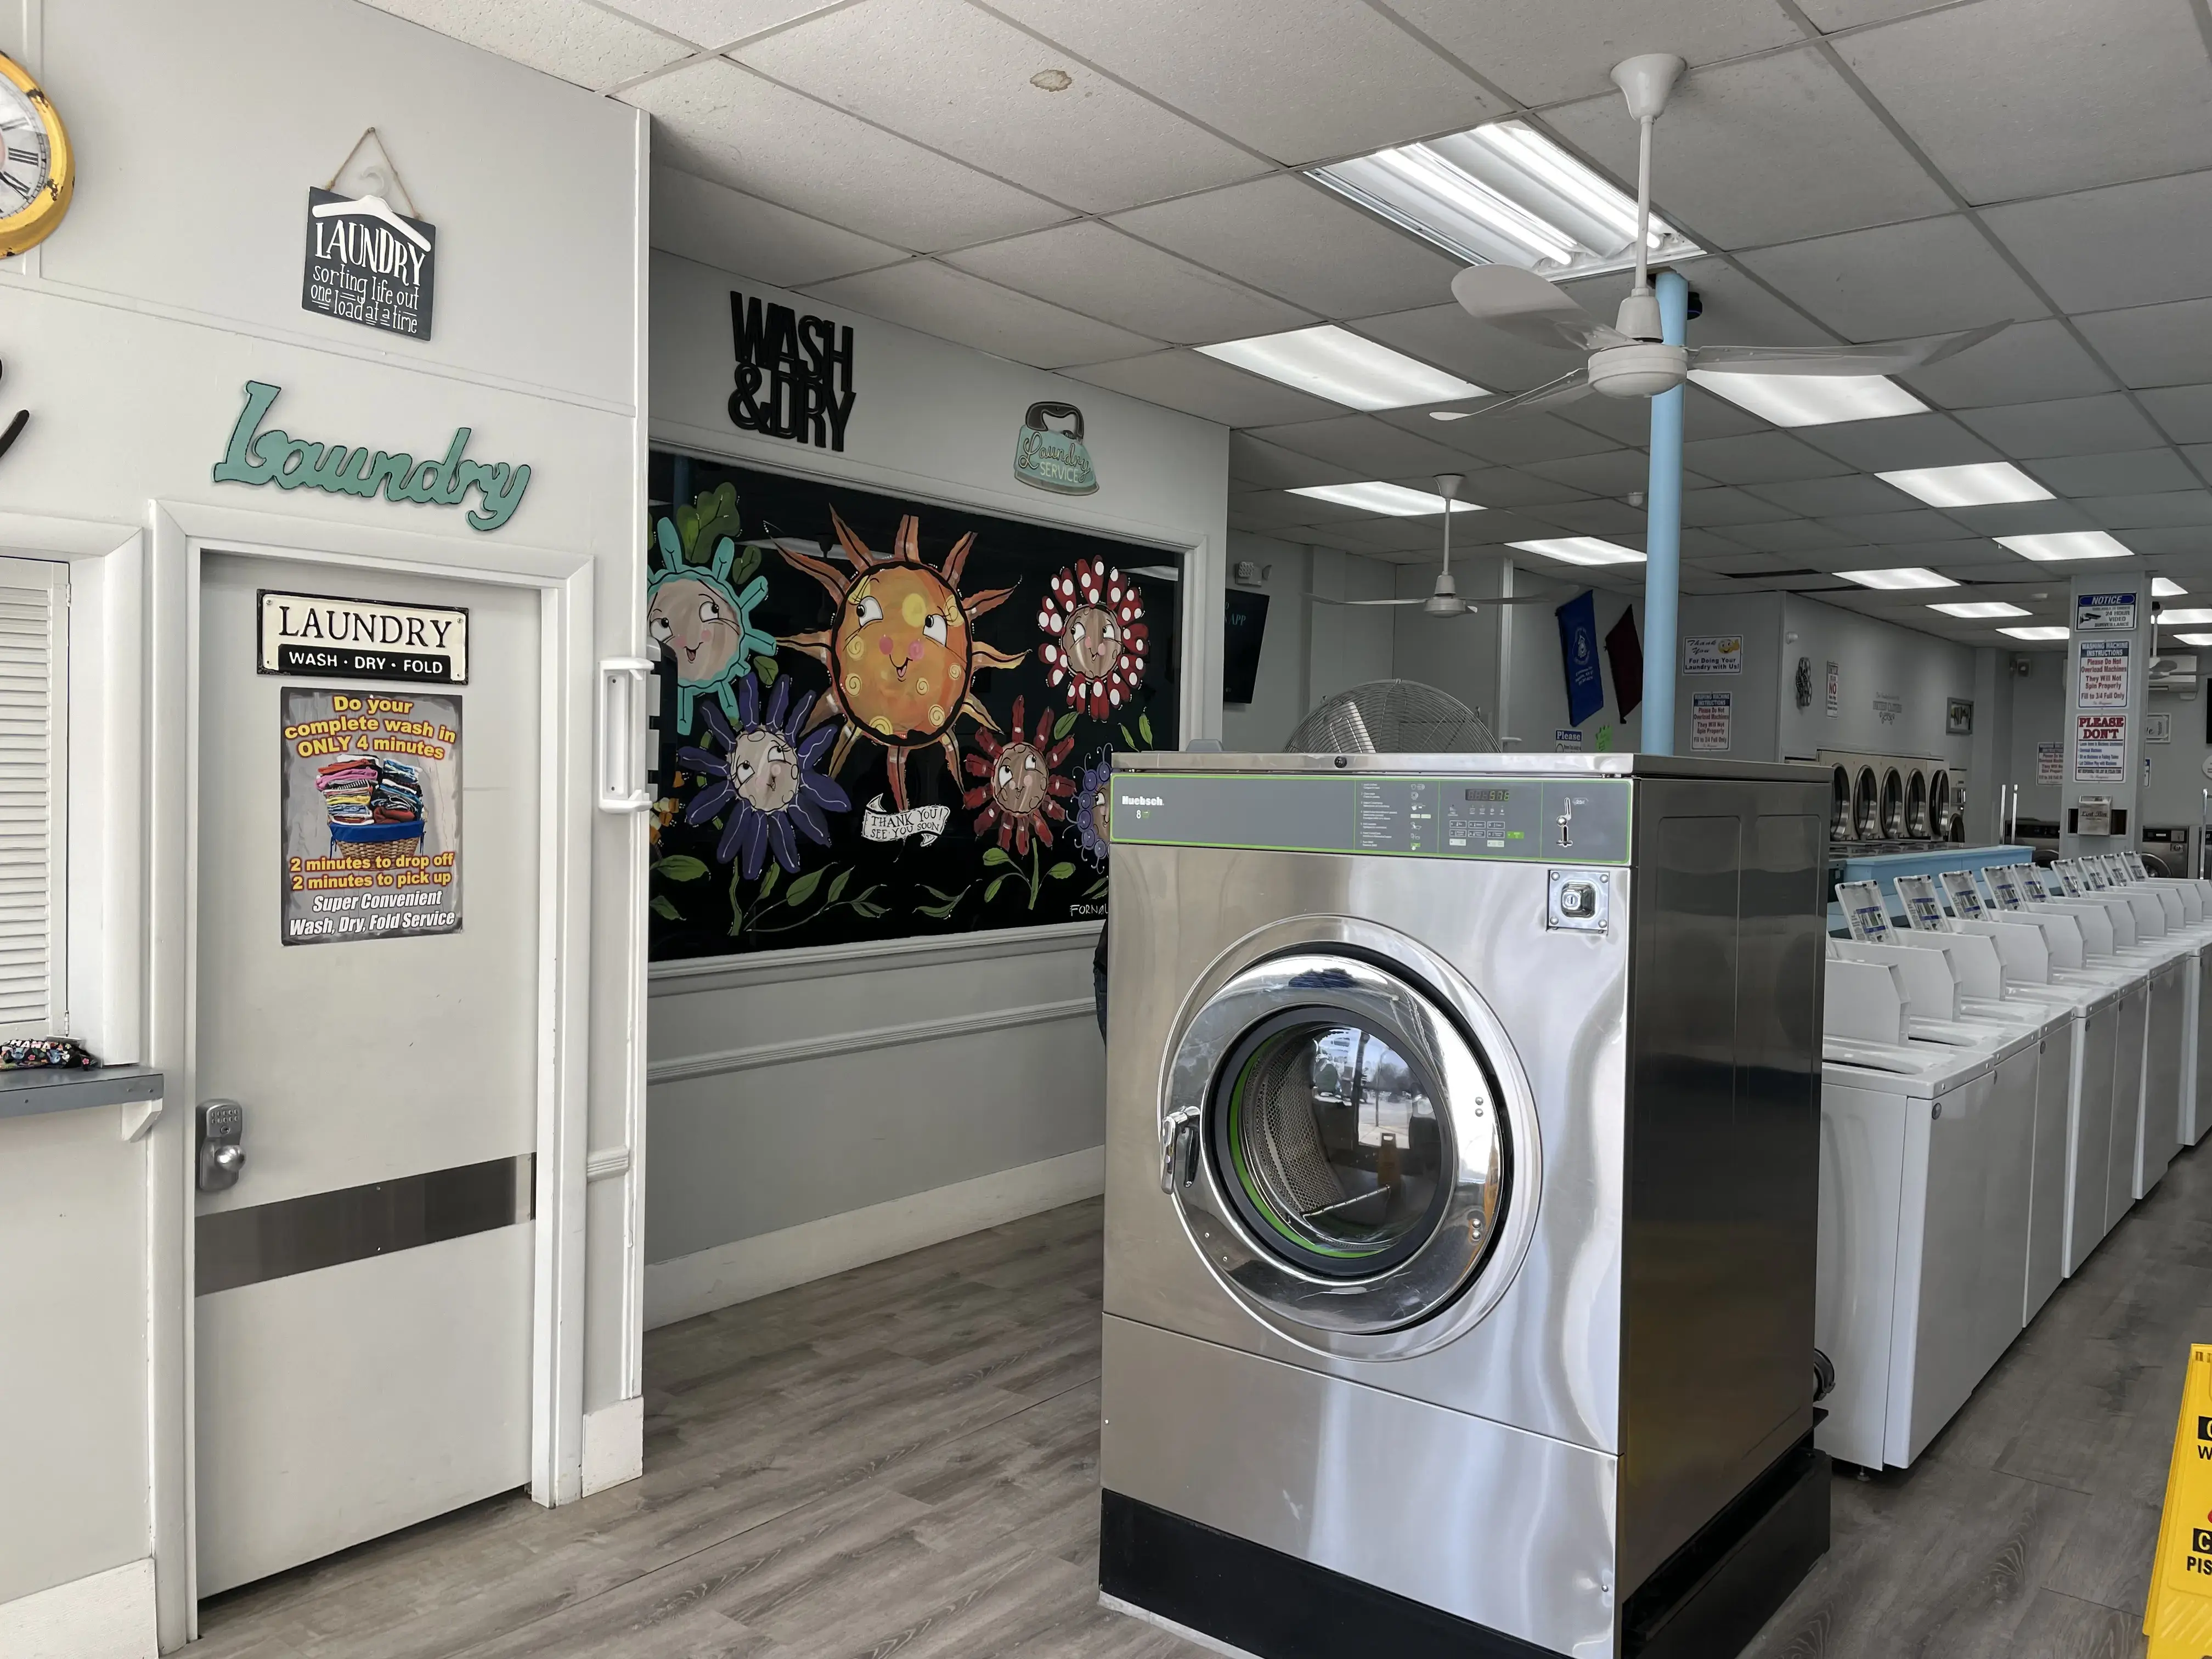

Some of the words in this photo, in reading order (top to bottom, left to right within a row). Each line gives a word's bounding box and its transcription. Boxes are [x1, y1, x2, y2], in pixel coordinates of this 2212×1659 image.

[315, 219, 426, 286] LAUNDRY
[313, 263, 368, 303] sorting
[371, 276, 393, 304] life
[396, 286, 419, 310] out
[311, 284, 332, 303] one
[334, 290, 364, 320] load
[365, 301, 379, 321] at
[382, 308, 390, 320] a
[393, 304, 417, 334] time
[730, 290, 854, 392] WASH
[212, 380, 532, 531] Laundry
[1018, 431, 1091, 483] Laundry
[1040, 461, 1080, 483] SERVICE
[2091, 596, 2123, 605] NOTICE
[278, 605, 453, 648] LAUNDRY
[289, 651, 338, 667] WASH
[354, 657, 386, 669] DRY
[404, 659, 443, 674] FOLD
[333, 695, 362, 712] Do
[367, 699, 413, 714] your
[284, 716, 379, 739] complete
[384, 720, 433, 737] wash
[439, 725, 456, 743] in
[2079, 717, 2124, 727] PLEASE
[2083, 728, 2119, 739] DON'T
[298, 735, 351, 757] ONLY
[357, 735, 369, 750] 4
[373, 736, 445, 759] minutes
[1556, 731, 1581, 740] Please
[871, 812, 915, 828] THANK
[917, 807, 943, 822] YOU!
[870, 828, 888, 839] SEE
[892, 825, 913, 838] YOU
[917, 822, 940, 832] SOON
[290, 857, 301, 871] 2
[306, 856, 371, 871] minutes
[375, 856, 392, 868] to
[396, 854, 430, 870] drop
[433, 852, 455, 866] off
[292, 876, 303, 890] 2
[308, 874, 373, 889] minutes
[377, 873, 393, 885] to
[397, 871, 430, 888] pick
[434, 873, 452, 885] up
[312, 895, 359, 913] Super
[360, 890, 442, 910] Convenient
[289, 917, 335, 936] Wash,
[338, 916, 366, 933] Dry,
[369, 913, 401, 930] Fold
[402, 911, 455, 929] Service
